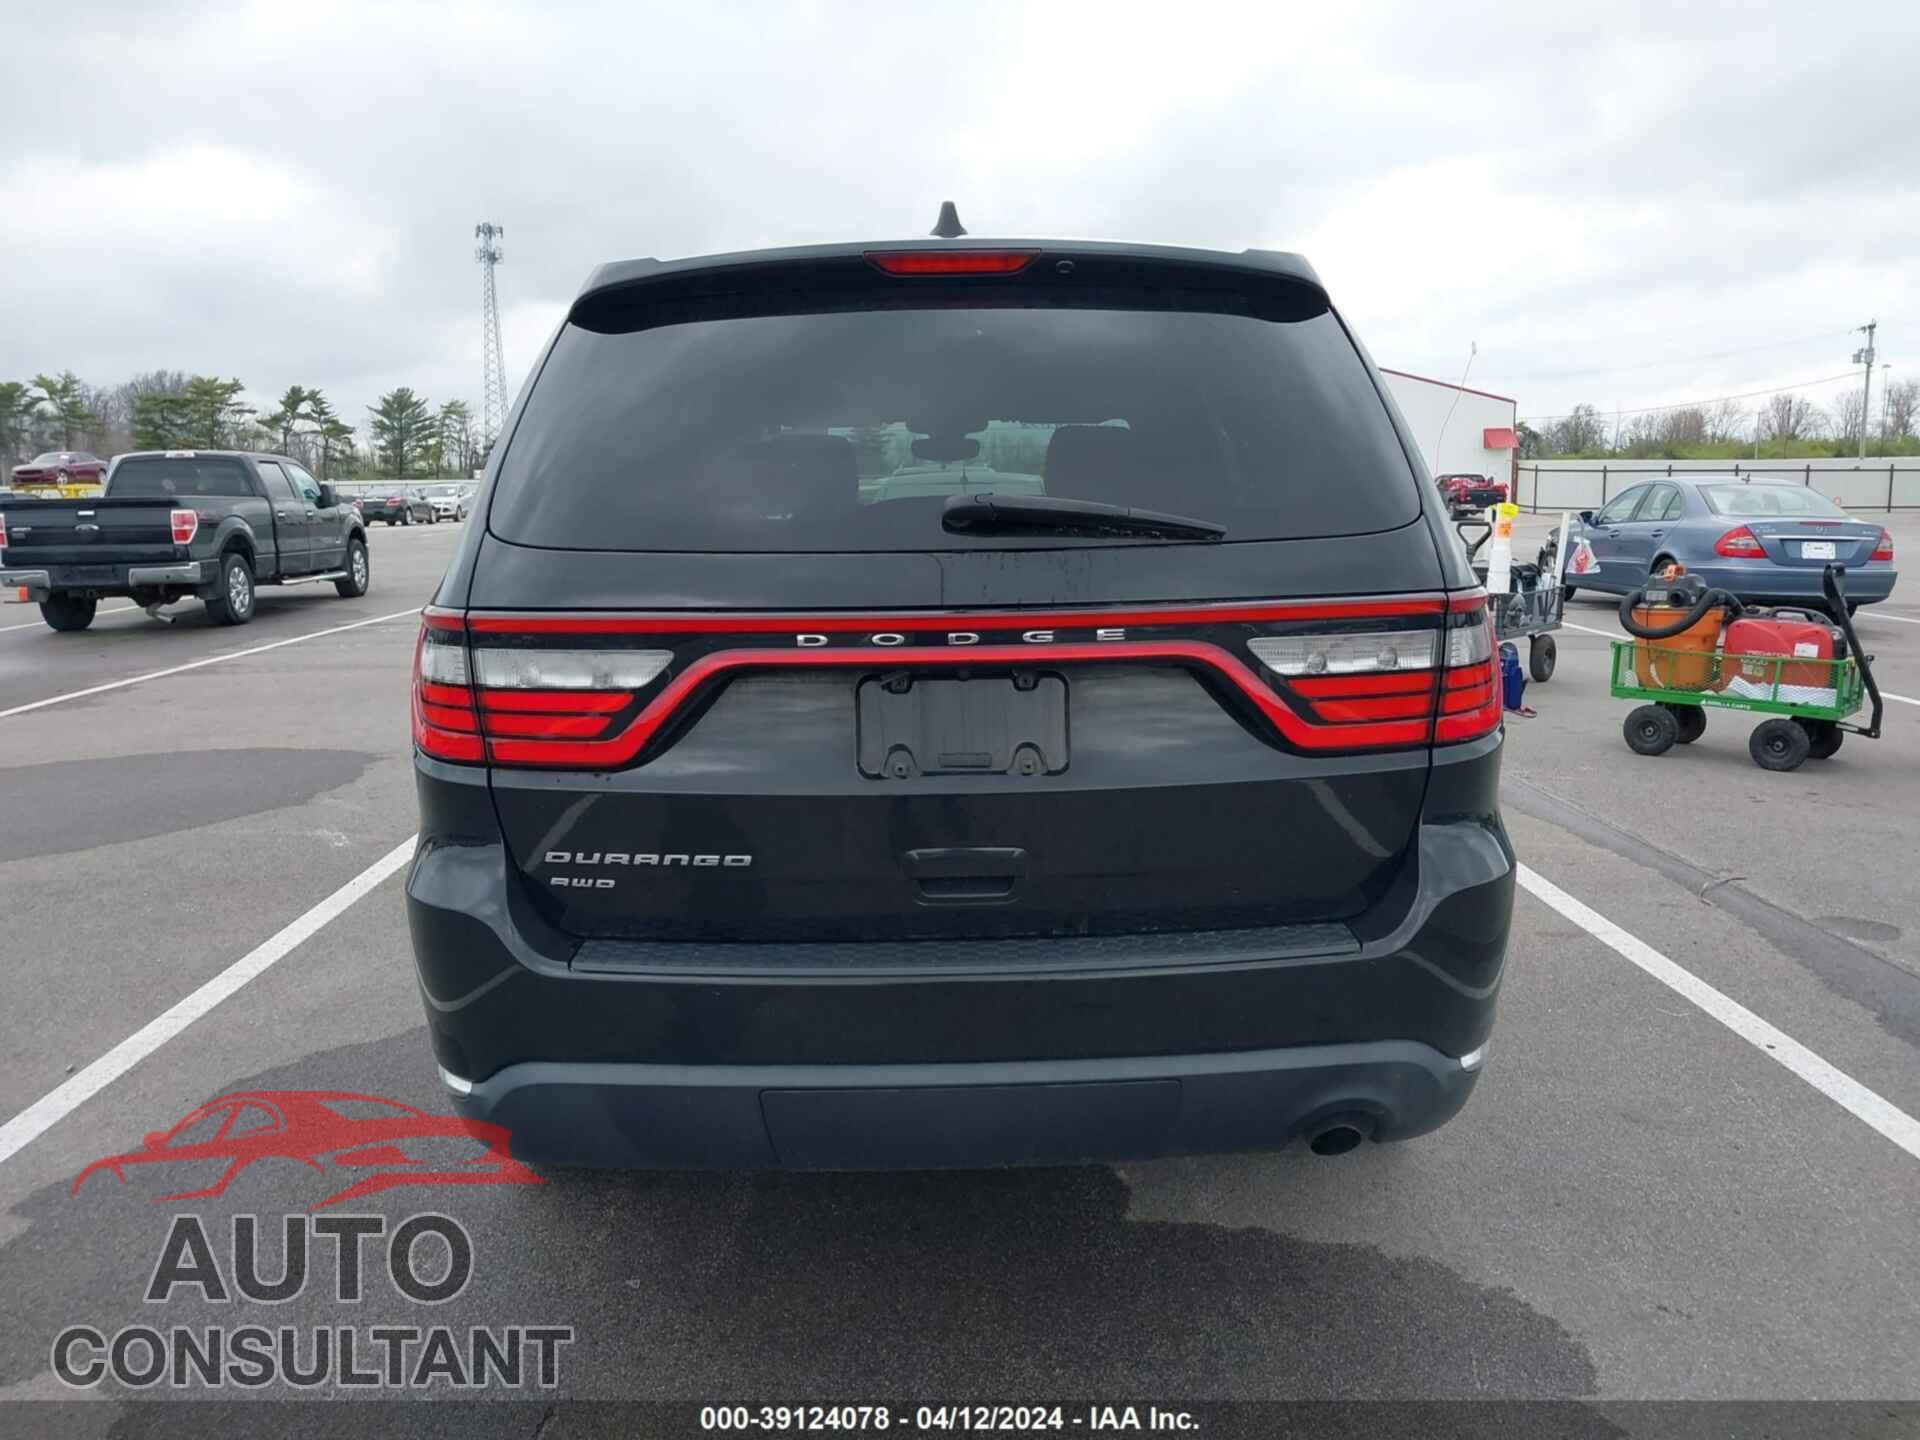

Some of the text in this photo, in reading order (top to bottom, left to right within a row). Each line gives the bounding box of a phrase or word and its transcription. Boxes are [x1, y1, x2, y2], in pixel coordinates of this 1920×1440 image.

[796, 628, 1126, 647] DODGE
[544, 851, 752, 866] DURANGO
[550, 877, 616, 888] AWD
